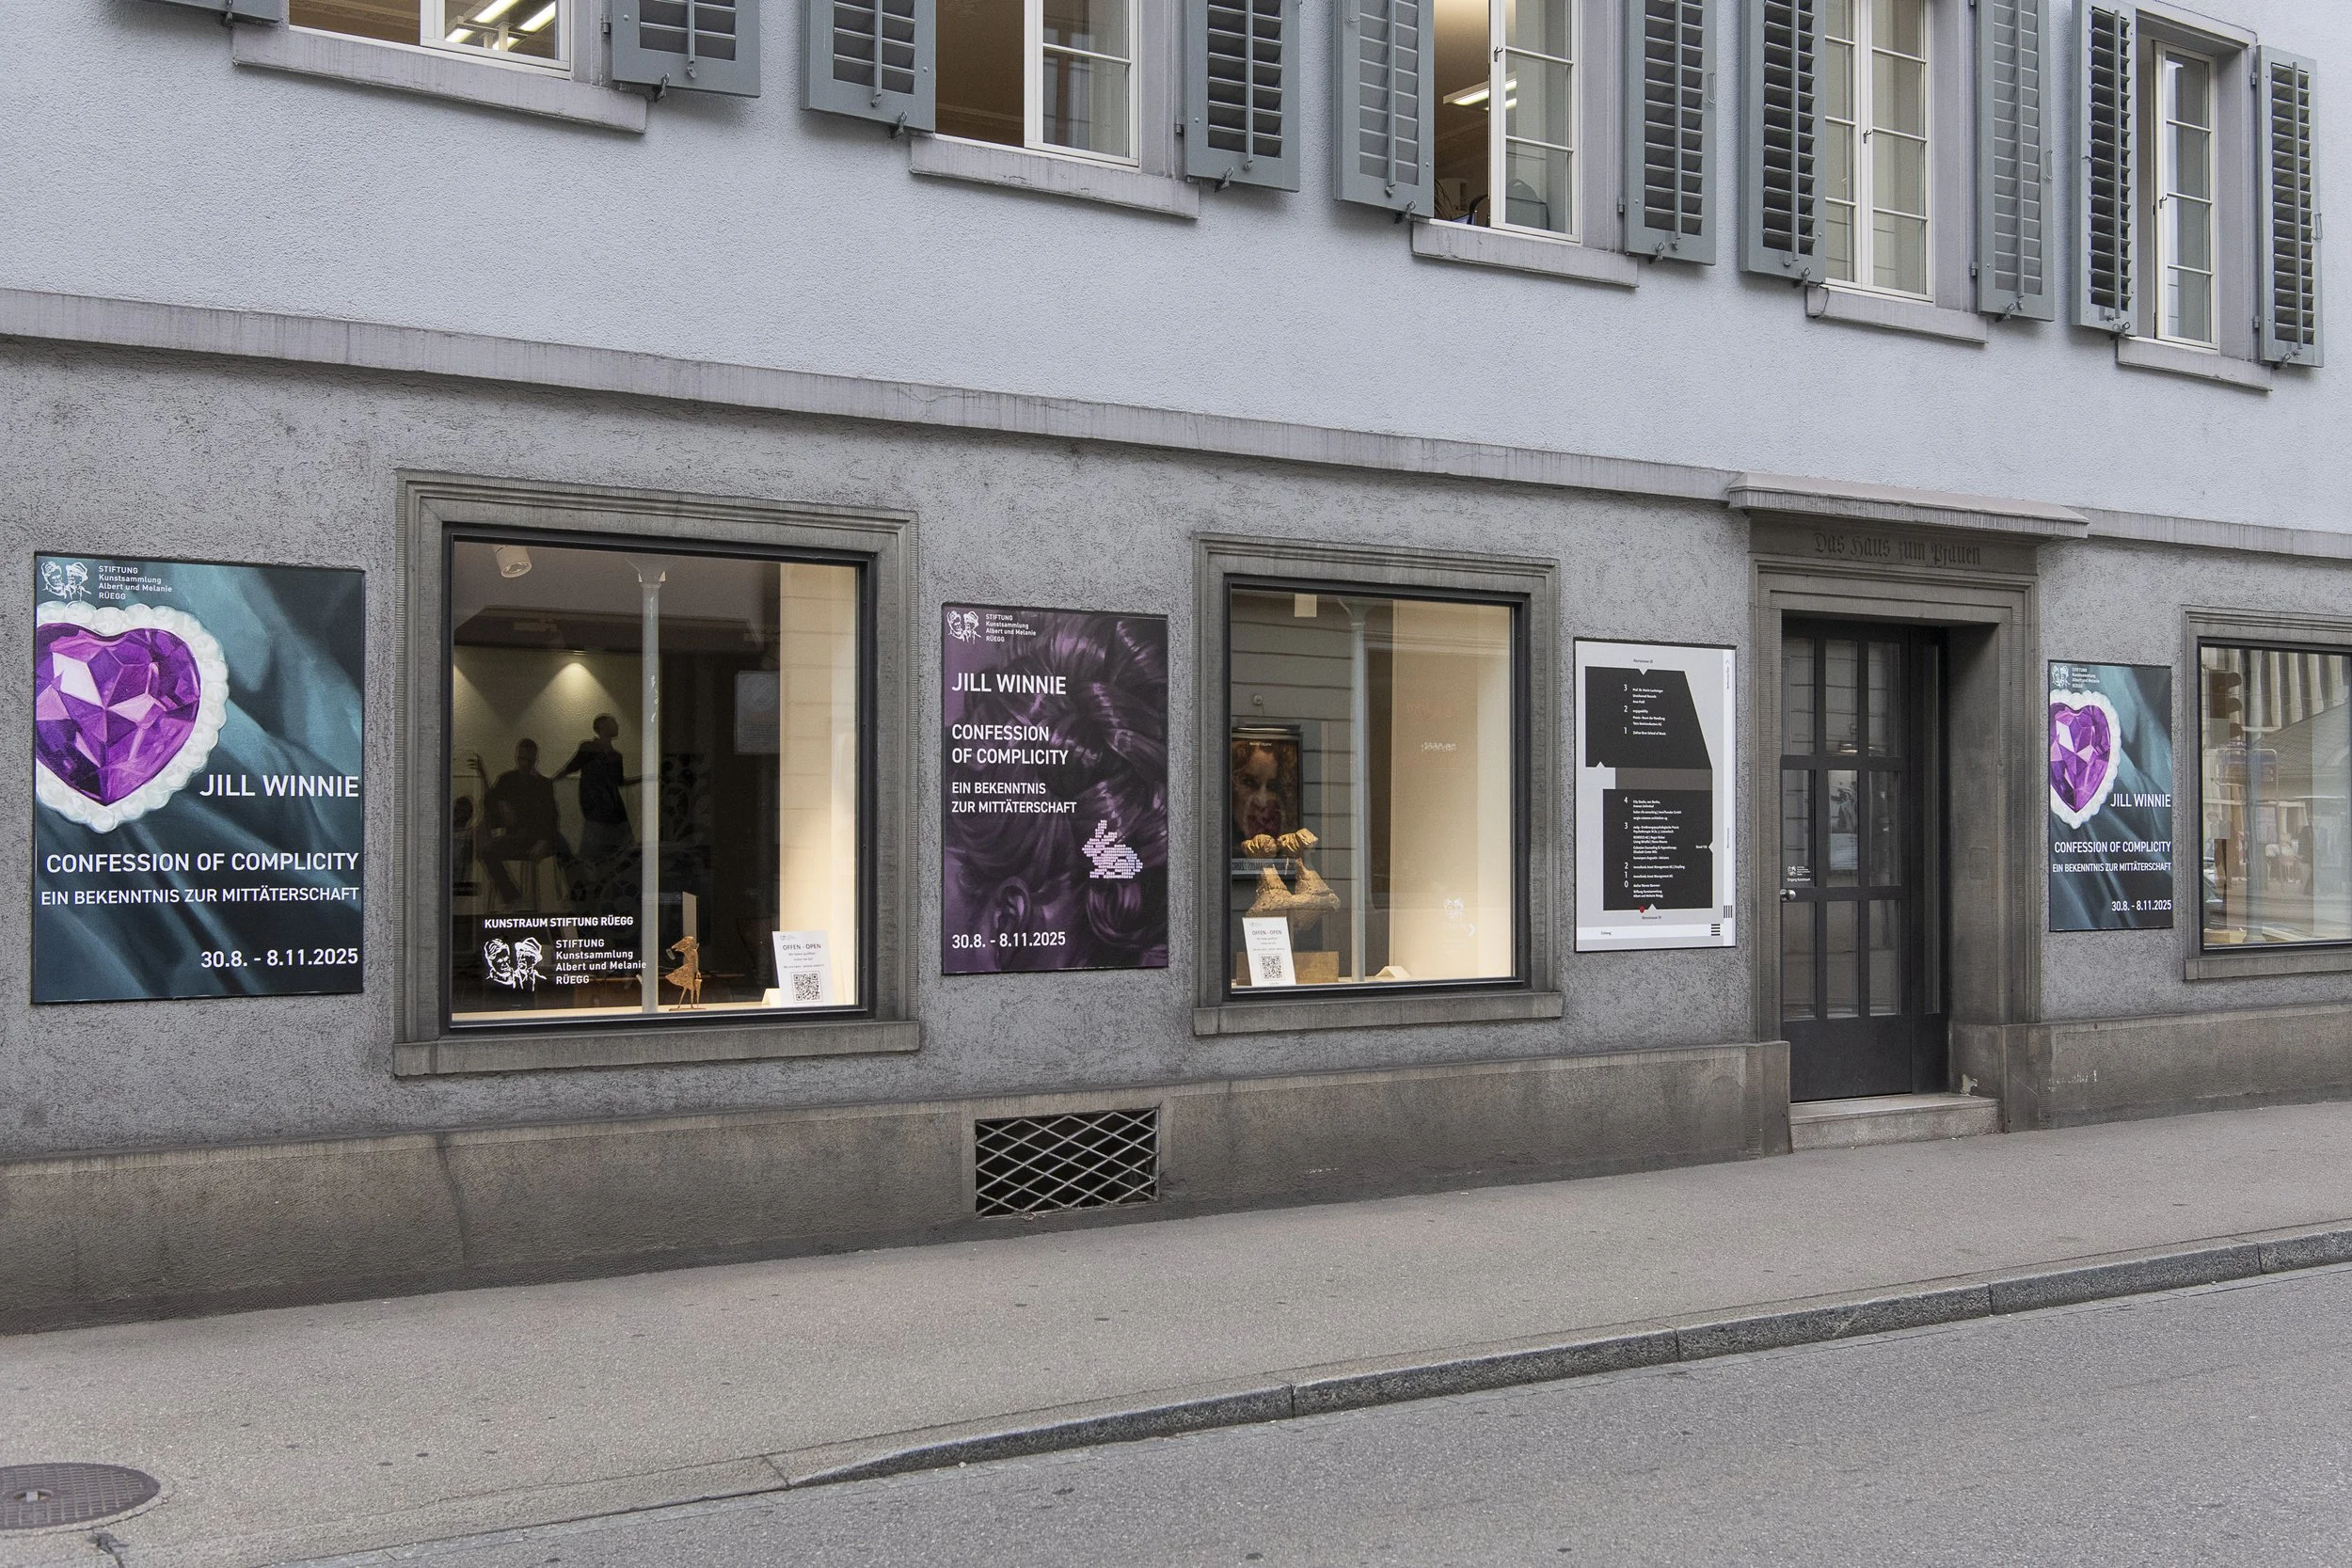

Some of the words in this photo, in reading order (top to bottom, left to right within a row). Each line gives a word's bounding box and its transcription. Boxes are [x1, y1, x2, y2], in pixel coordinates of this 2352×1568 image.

[1814, 532, 1845, 554] Das
[1850, 535, 1891, 558] Haus
[1899, 540, 1926, 562] zum
[99, 565, 138, 574] STIFTUNG
[99, 575, 162, 584] Kunstsammlung
[99, 592, 126, 600] RÜEGG
[952, 673, 992, 692] JILL
[996, 673, 1066, 695] WINNIE
[952, 724, 1049, 741] CONFESSION
[952, 748, 972, 763] OF
[977, 748, 1069, 765] COMPLICITY
[199, 775, 255, 797] JILL
[262, 775, 359, 798] WINNIE
[952, 783, 971, 794] EIN
[975, 783, 1046, 795] BEKENNTNIS
[952, 801, 977, 813] ZUR
[978, 799, 1077, 814] MITTÄTERSCHAFT
[2110, 794, 2132, 807] JILL
[2134, 794, 2171, 807] WINNIE
[2055, 841, 2107, 853] CONFESSION
[2109, 841, 2121, 852] OF
[2122, 841, 2171, 852] COMPLICITY
[46, 852, 189, 873] CONFESSION
[196, 853, 225, 871] OF
[231, 852, 359, 871] COMPLICITY
[2053, 863, 2063, 873] EIN
[2064, 863, 2105, 872] BEKENNTNIS
[2105, 863, 2118, 872] ZUR
[2119, 861, 2171, 872] MITTÄTERSCHAFT
[41, 891, 69, 906] EIN
[74, 889, 180, 904] BEKENNTNIS
[184, 889, 217, 903] ZUR
[222, 885, 359, 902] MITTÄTERSCHAFT
[2111, 900, 2130, 911] 30.8.
[2136, 899, 2171, 911] 8.11.2025
[485, 918, 548, 928] KUNSTRAUM
[549, 917, 598, 927] STIFTUNG
[600, 914, 633, 927] RÜEGG
[555, 939, 605, 949] STIFTUNG
[952, 933, 986, 949] 30.8.
[999, 931, 1066, 947] 8.11.2025
[200, 950, 248, 968] 30.8.
[266, 947, 358, 966] 8.11.2025
[555, 950, 633, 960] Kunstsammlung
[555, 961, 586, 972] Albert
[589, 961, 607, 970] und
[609, 959, 646, 970] Melanie
[555, 974, 590, 985] RÜEGG
